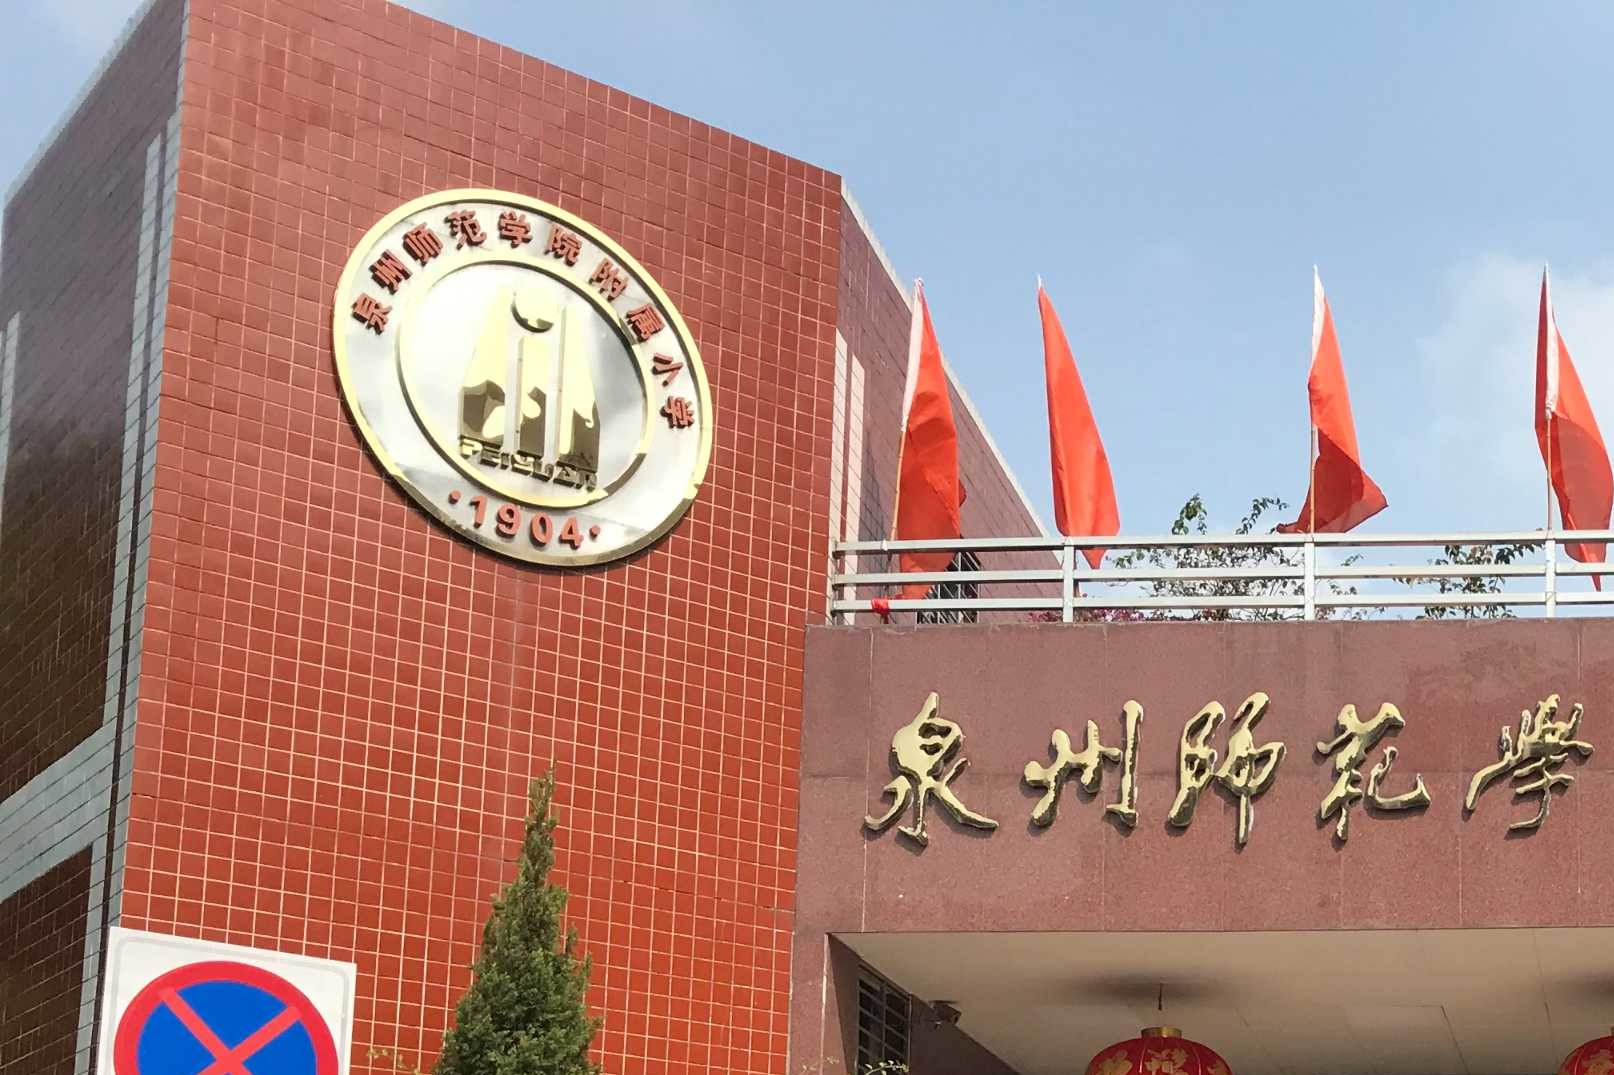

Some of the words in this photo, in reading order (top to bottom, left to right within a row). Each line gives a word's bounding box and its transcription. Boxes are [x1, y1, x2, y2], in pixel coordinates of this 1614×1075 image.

[351, 210, 695, 430] 泉州师范学院附属小学
